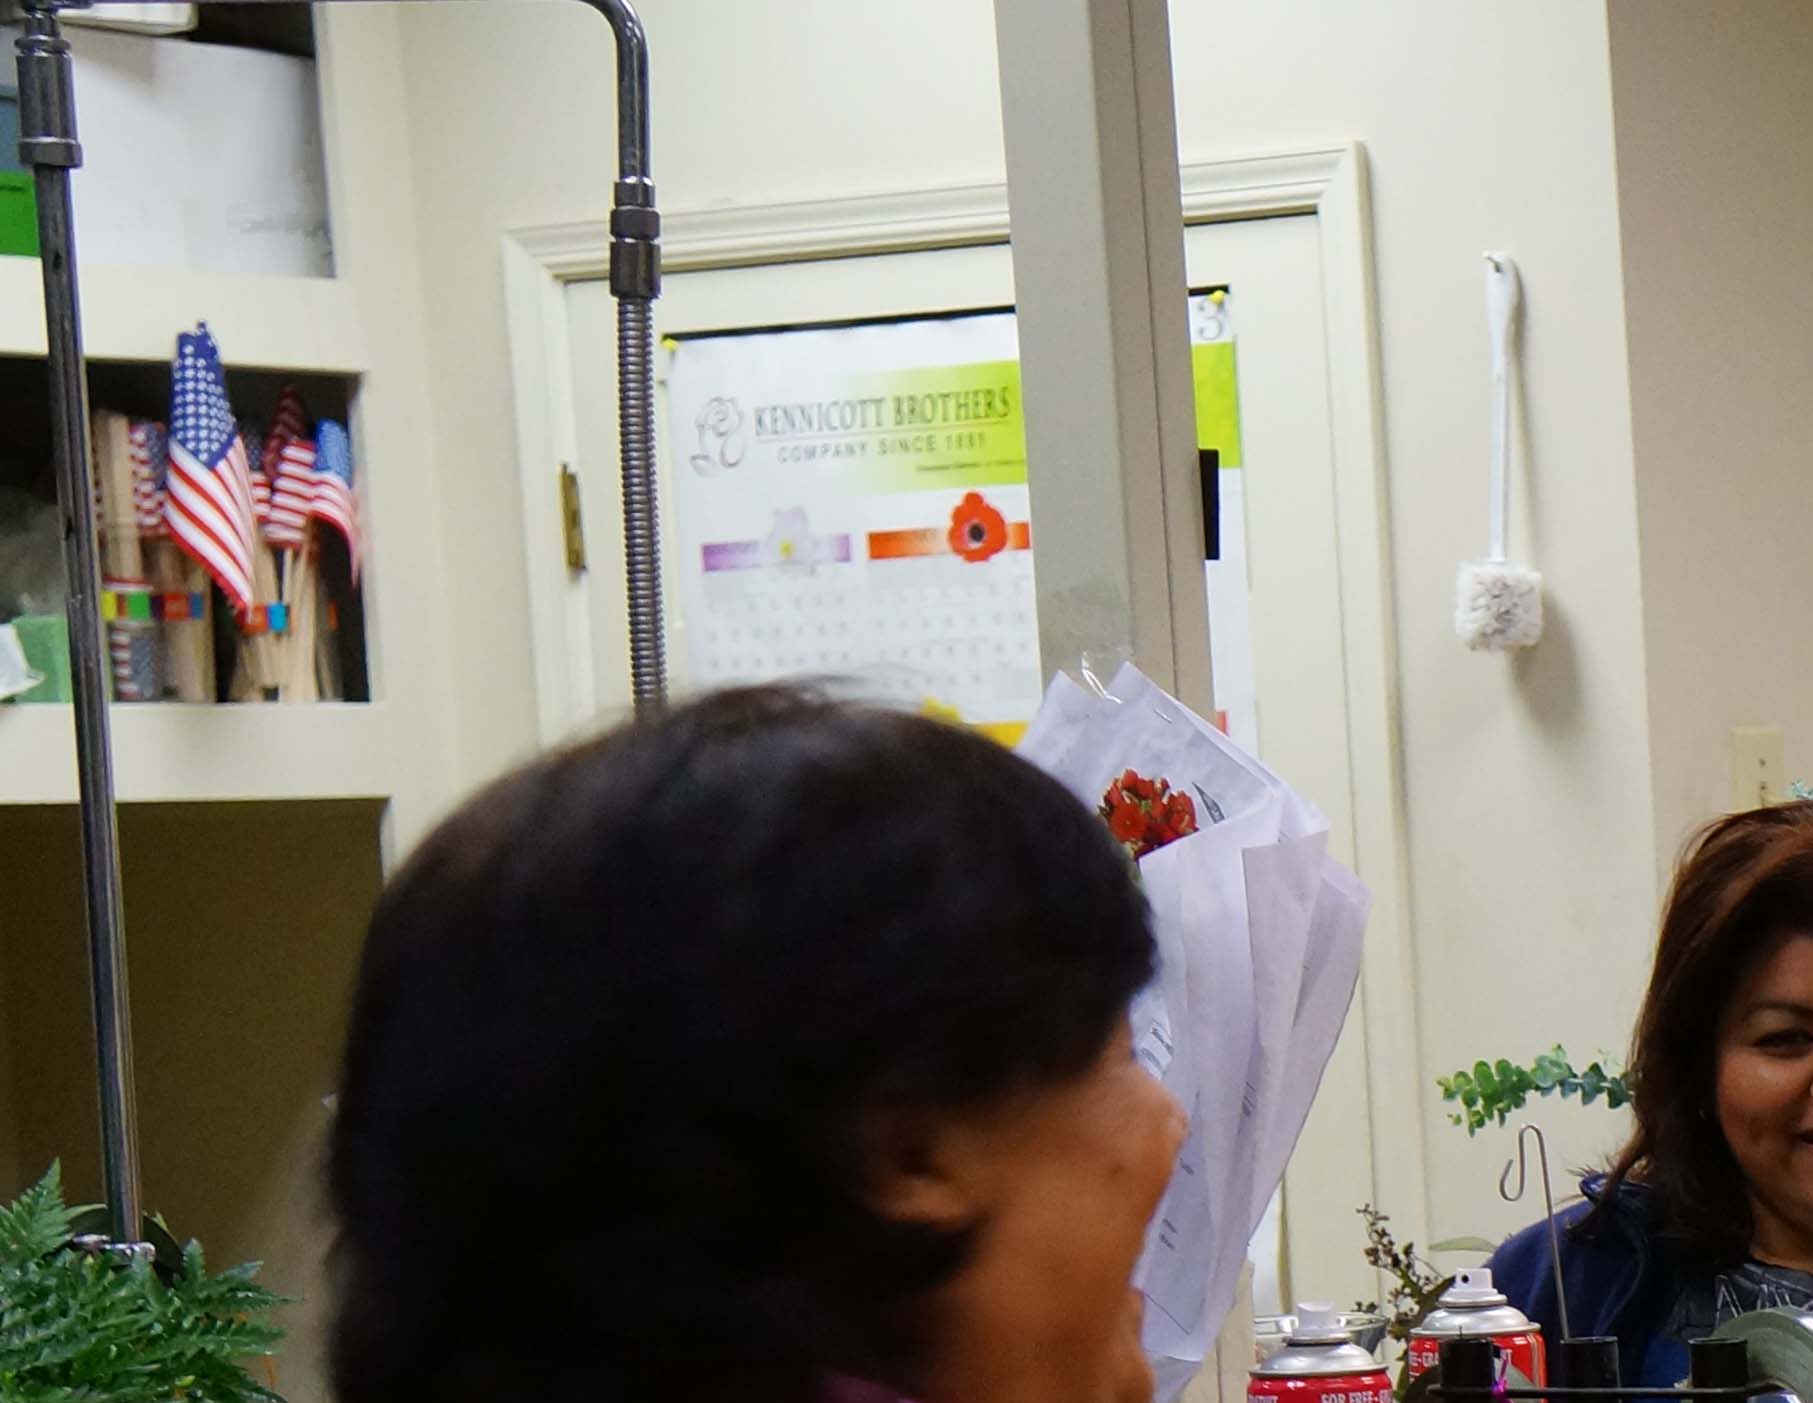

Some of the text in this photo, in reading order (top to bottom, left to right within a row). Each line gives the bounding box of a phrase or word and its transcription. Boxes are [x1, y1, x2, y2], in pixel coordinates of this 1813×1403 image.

[754, 386, 1010, 436] KENNICOTT BROTHERS
[777, 442, 868, 465] COMPANY
[877, 434, 936, 457] SINCE
